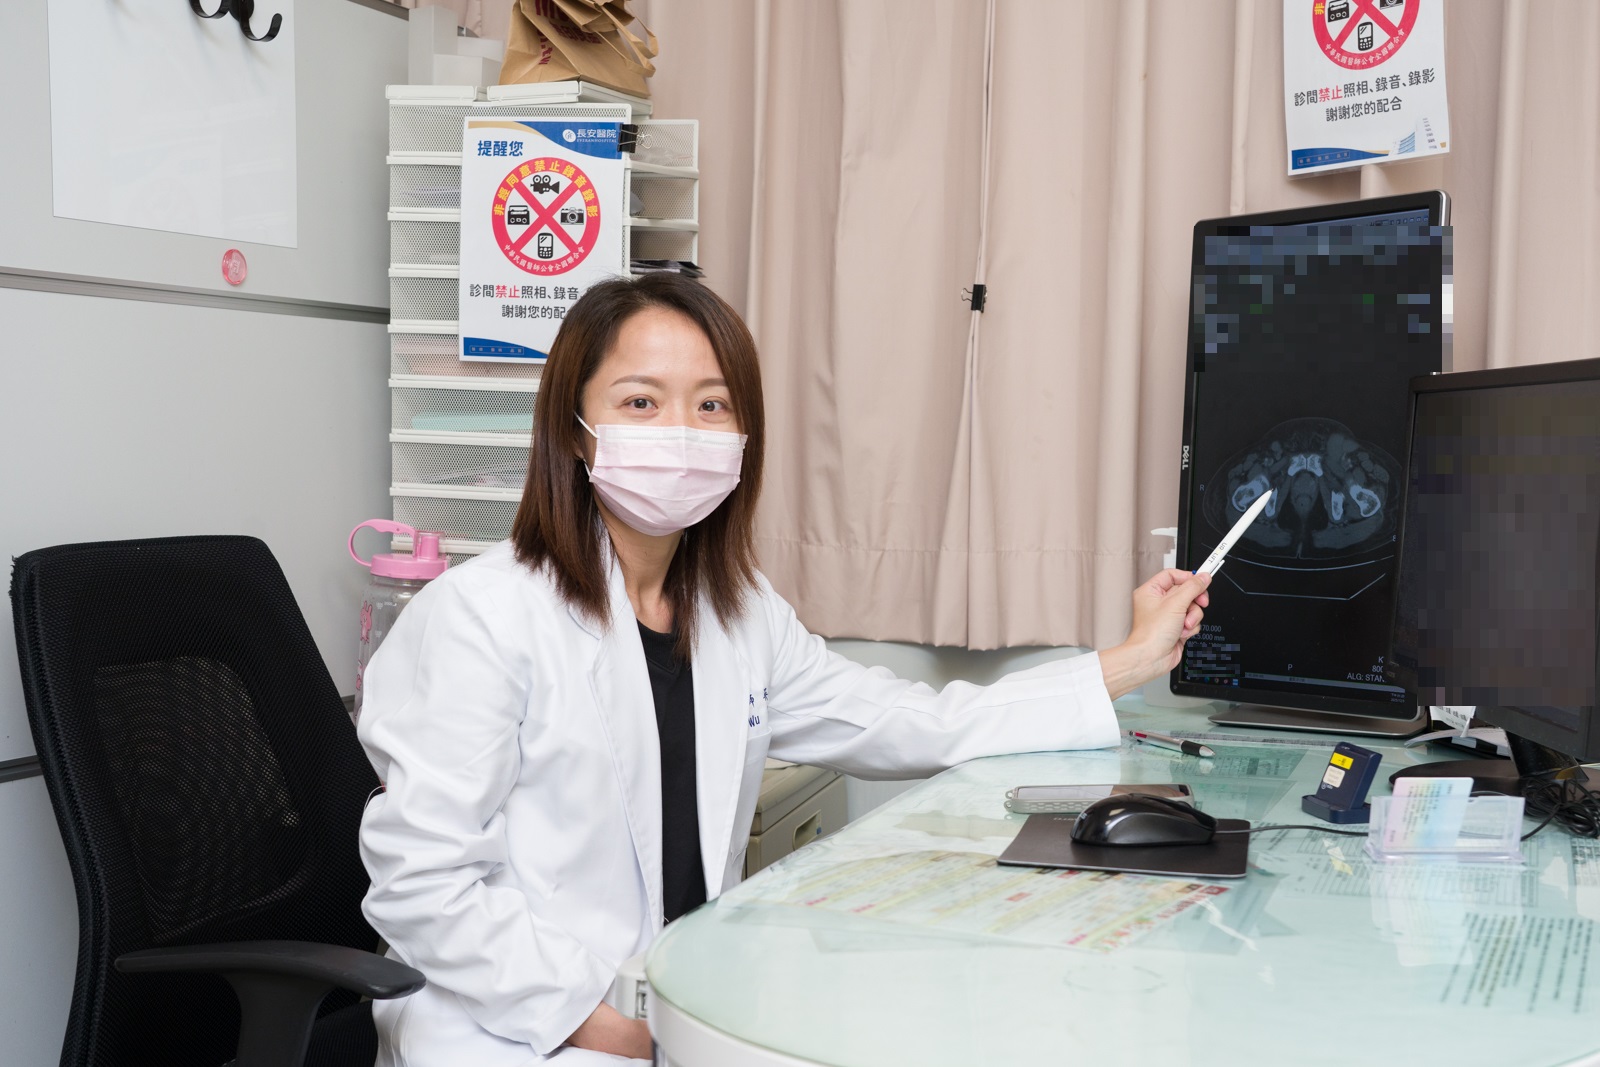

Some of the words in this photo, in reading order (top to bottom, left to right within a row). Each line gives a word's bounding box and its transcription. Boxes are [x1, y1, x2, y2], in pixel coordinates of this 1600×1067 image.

[1294, 67, 1435, 107] 診間禁止照相、錄音、錄影
[1325, 95, 1403, 122] 謝謝您的配合
[576, 128, 617, 138] 長安醫院
[477, 139, 524, 157] 提醒您
[493, 159, 598, 218] 非經同意禁止錄音錄影
[469, 283, 580, 300] 診間禁止照相、錄音
[501, 304, 567, 320] 謝謝您的配
[1181, 444, 1190, 471] DELL
[1287, 663, 1293, 671] P
[1346, 672, 1364, 681] ALG:
